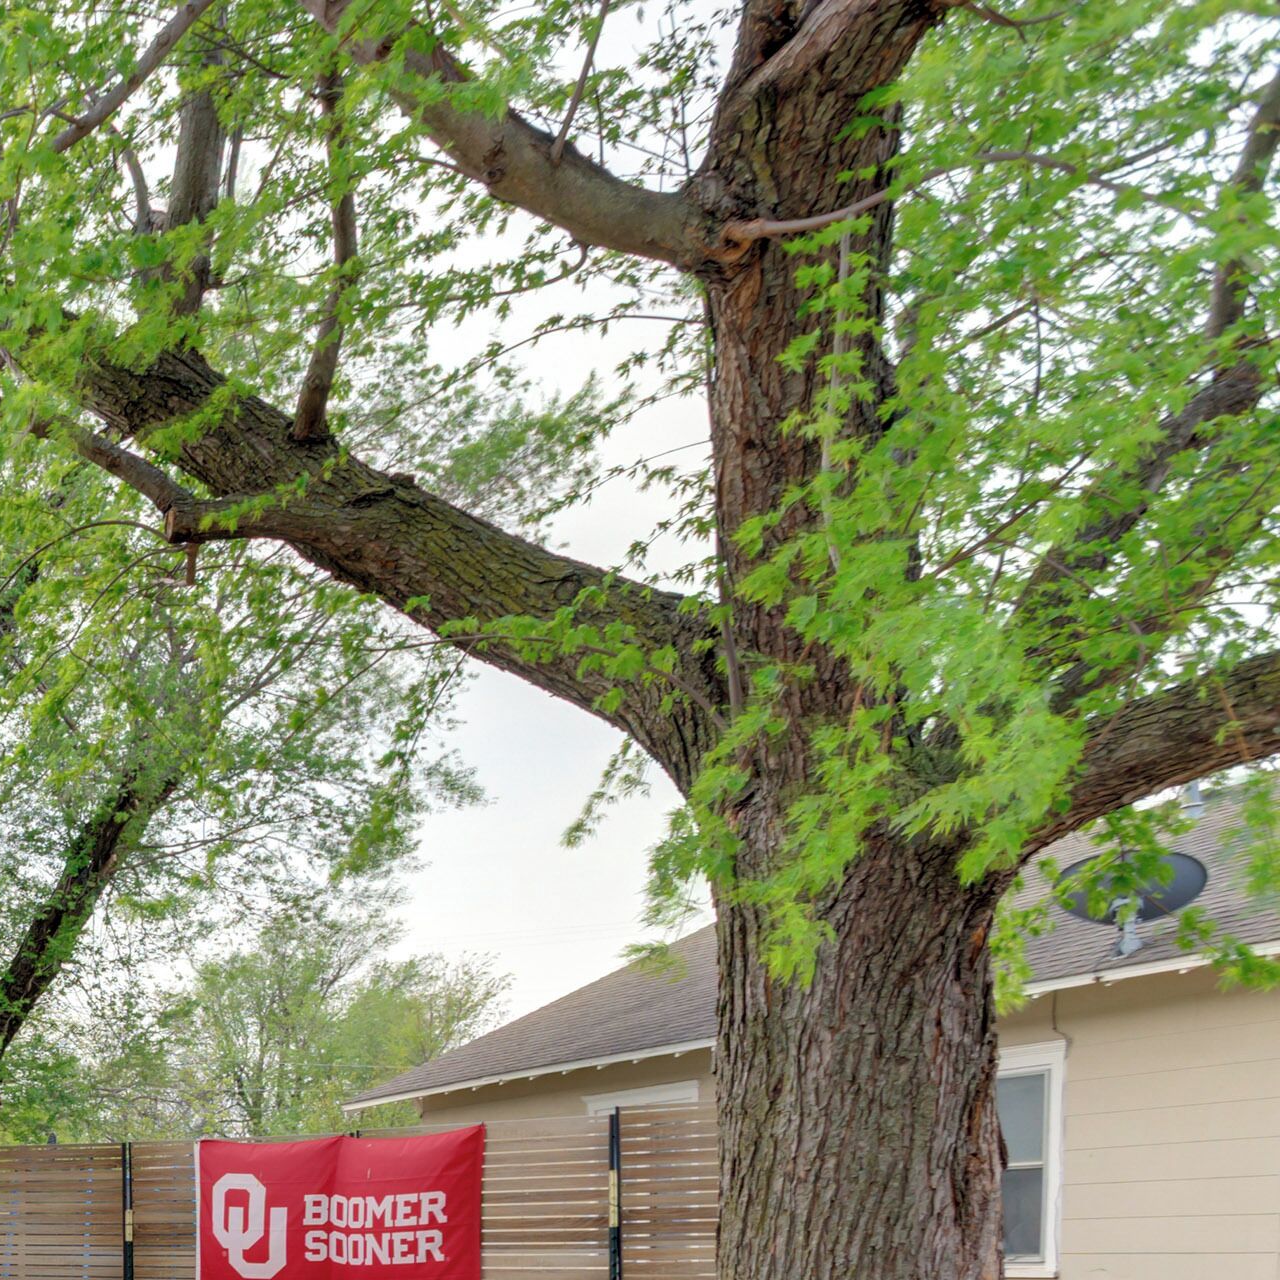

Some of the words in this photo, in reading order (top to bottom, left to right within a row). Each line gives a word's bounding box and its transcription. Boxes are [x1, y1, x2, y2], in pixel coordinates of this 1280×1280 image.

[212, 1173, 287, 1279] OU
[303, 1191, 447, 1229] BOOMER
[304, 1229, 445, 1266] SOONER
